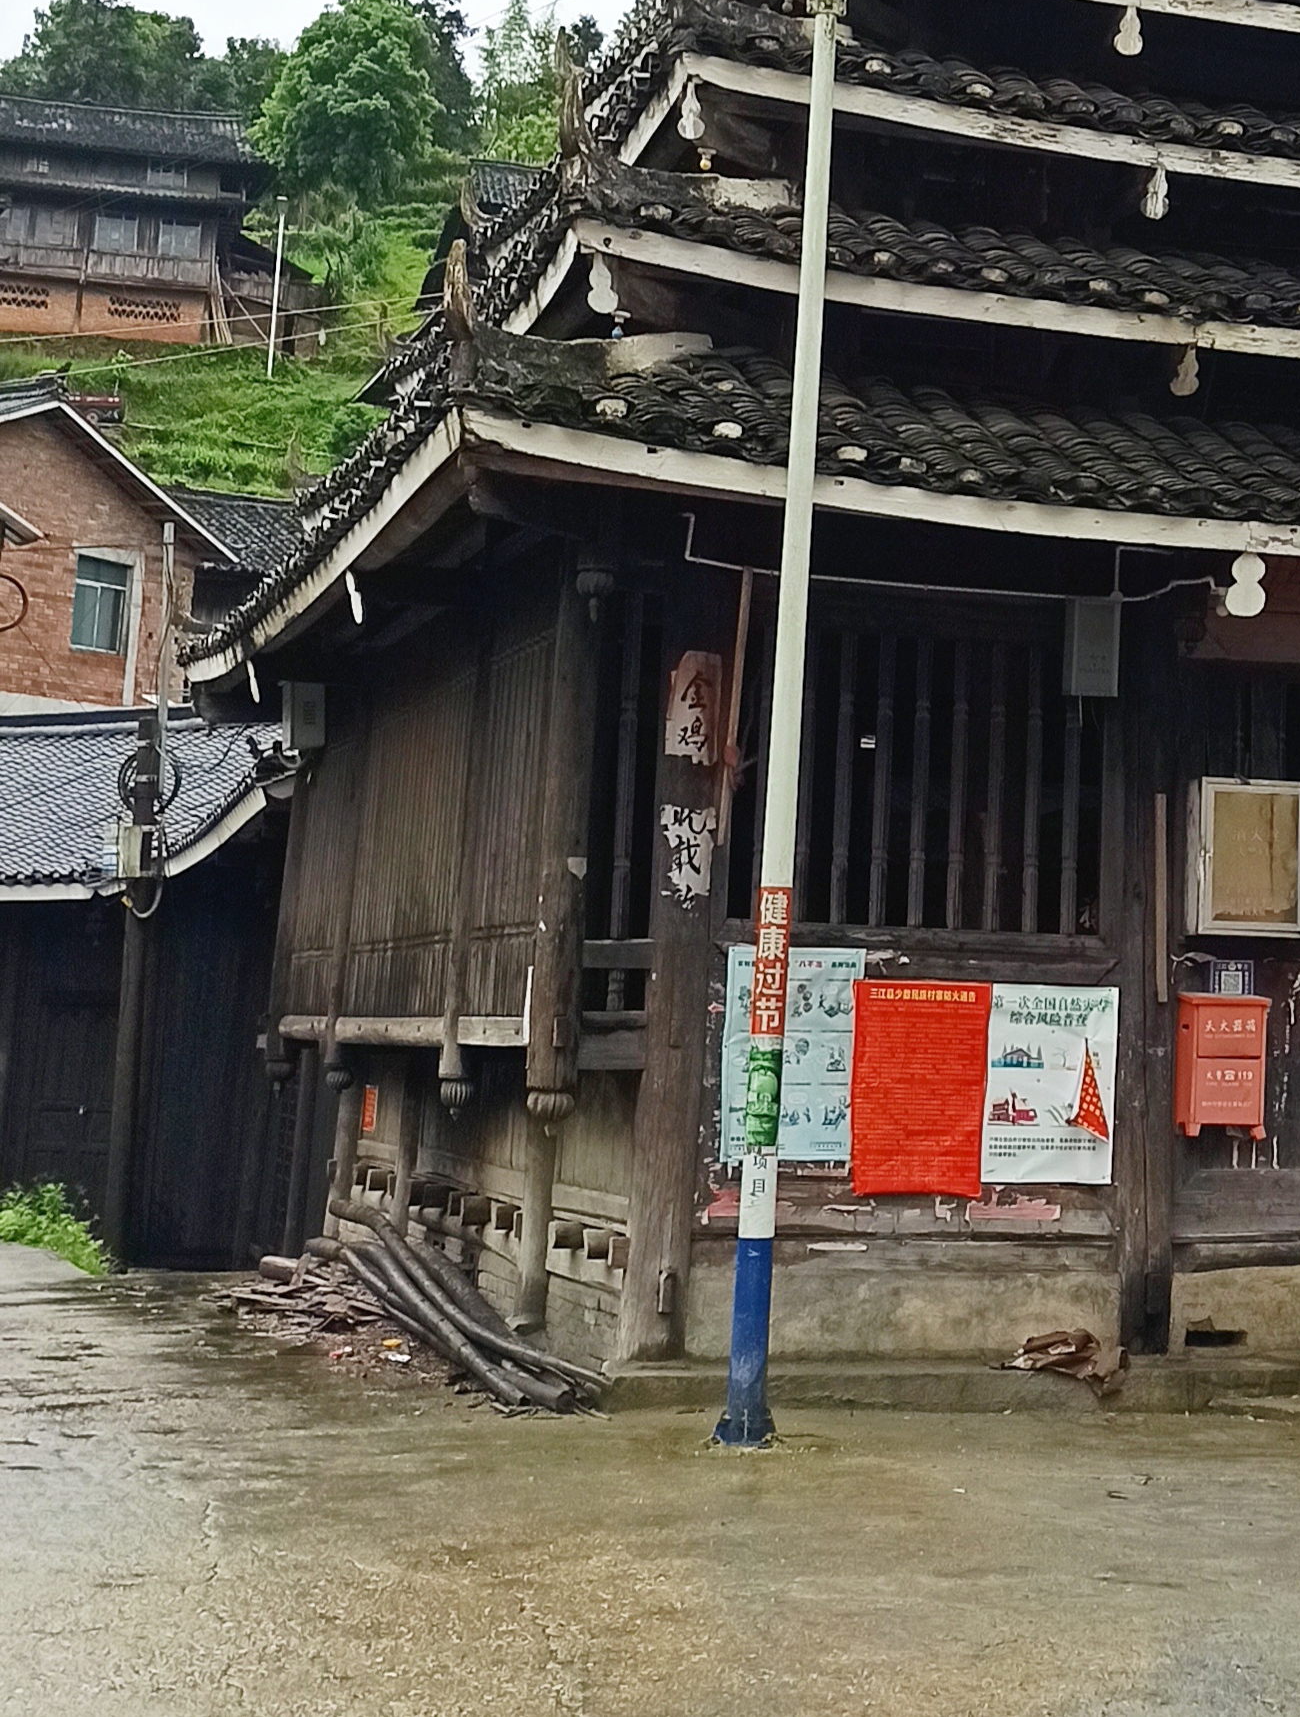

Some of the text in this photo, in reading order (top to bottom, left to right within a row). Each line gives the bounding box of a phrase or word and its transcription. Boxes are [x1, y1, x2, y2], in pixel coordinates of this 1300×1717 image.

[756, 890, 789, 1032] 健康过节
[1009, 1010, 1088, 1027] 综合风险普查
